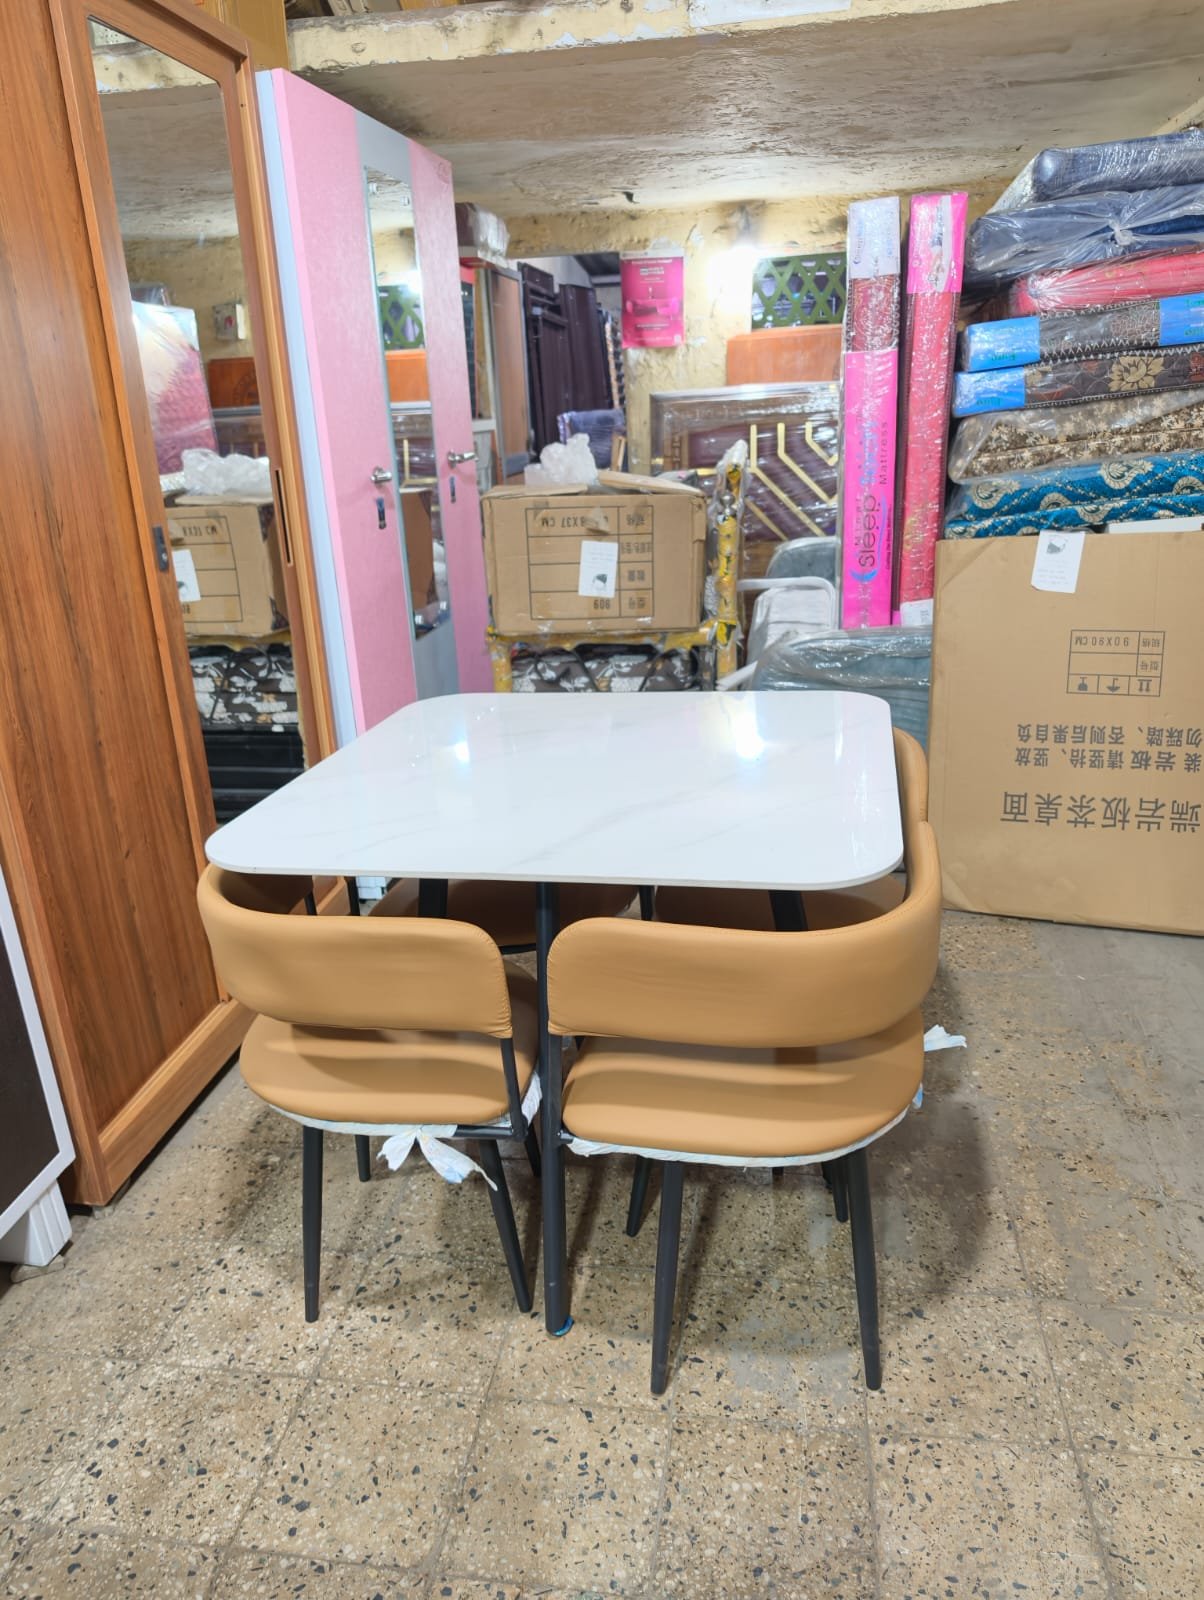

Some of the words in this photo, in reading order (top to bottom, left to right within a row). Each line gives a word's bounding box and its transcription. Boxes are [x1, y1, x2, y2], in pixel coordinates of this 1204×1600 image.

[880, 421, 888, 485] Mattress
[858, 495, 878, 567] Sleep
[1140, 660, 1160, 671] 型号
[1001, 791, 1202, 833] 端岩板茶桌面
